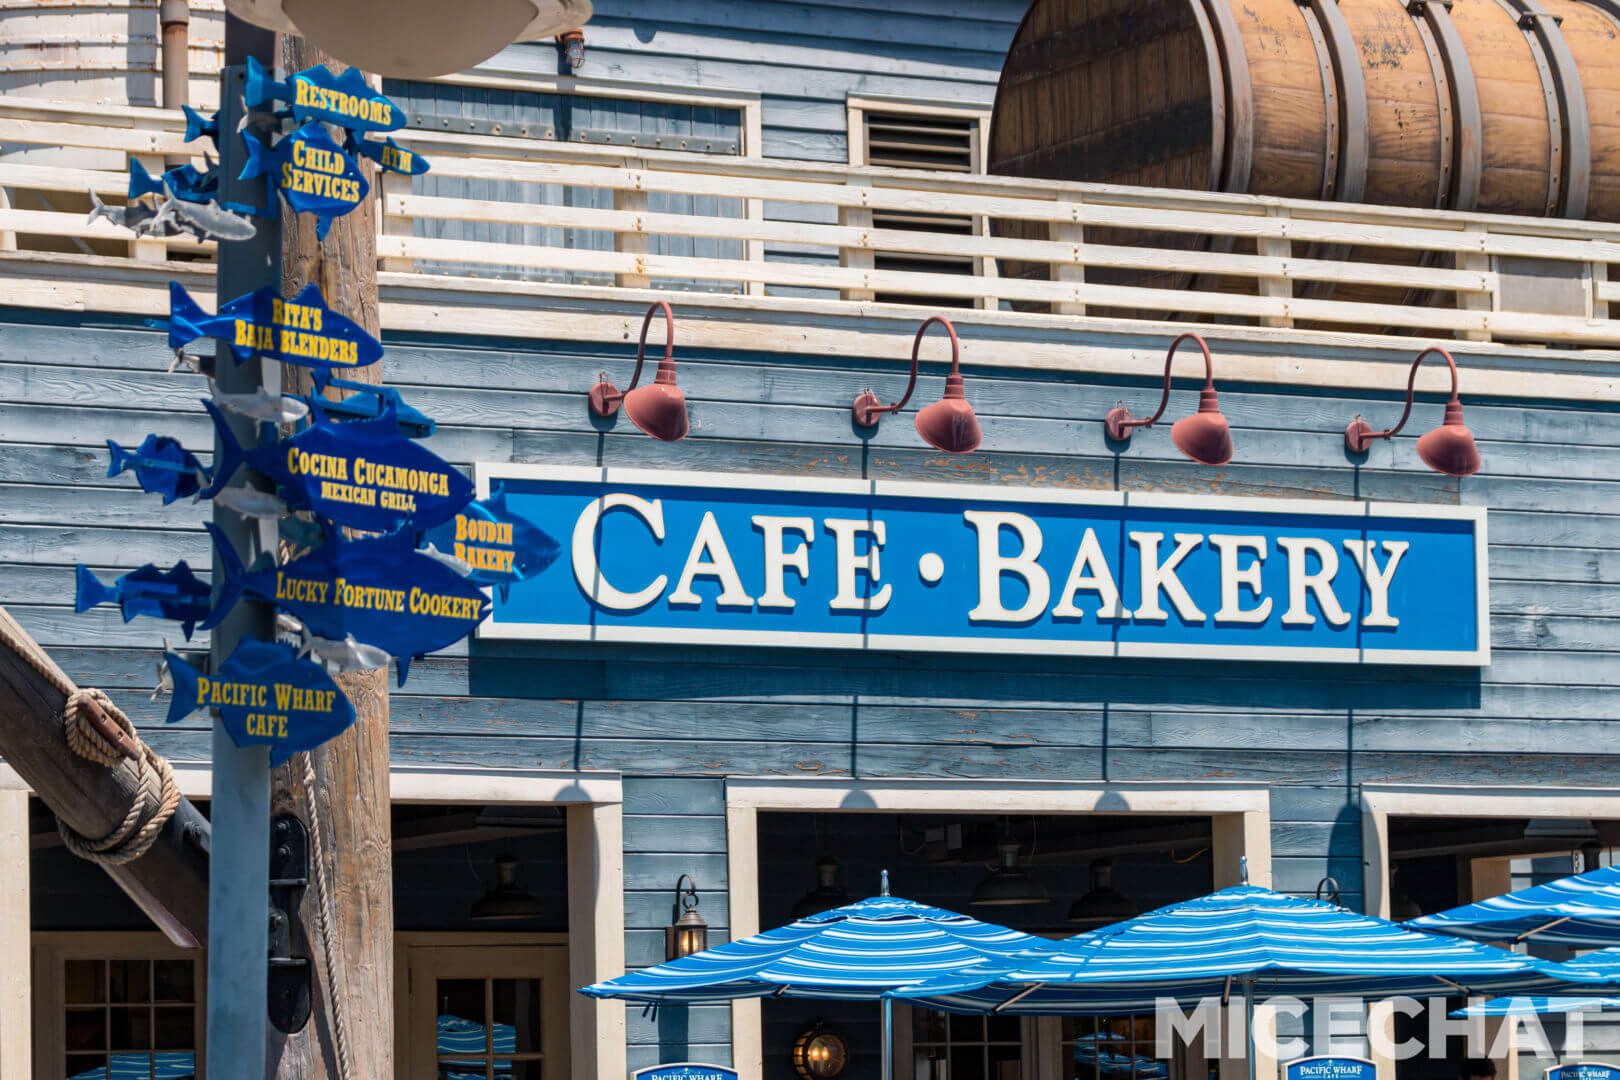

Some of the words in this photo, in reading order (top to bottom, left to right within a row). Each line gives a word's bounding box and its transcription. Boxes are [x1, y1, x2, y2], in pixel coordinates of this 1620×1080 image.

[295, 78, 392, 126] RESTROOMS
[293, 140, 345, 175] CHILD
[381, 145, 412, 172] ATM
[281, 162, 360, 203] SERVICES
[272, 298, 322, 331] RITA'S
[235, 319, 274, 351] BAJA
[280, 330, 358, 365] BLENDERS
[288, 447, 348, 480] COCINA
[353, 457, 449, 496] CUCAMONGA
[321, 481, 376, 506] MEXICAN
[380, 489, 416, 512] GRILL
[455, 513, 513, 546] BOUDIN
[572, 491, 893, 613] CAFE
[963, 509, 1411, 629] BAKERY
[276, 571, 329, 603] LUCKY
[334, 577, 405, 613] FORTUNE
[409, 586, 482, 620] COOKERY
[196, 677, 267, 707] PACIFIC
[274, 683, 336, 712] WHARF
[246, 714, 289, 738] CAFE
[1300, 1066, 1331, 1076] PACIFIC
[1333, 1065, 1363, 1075] WHARF
